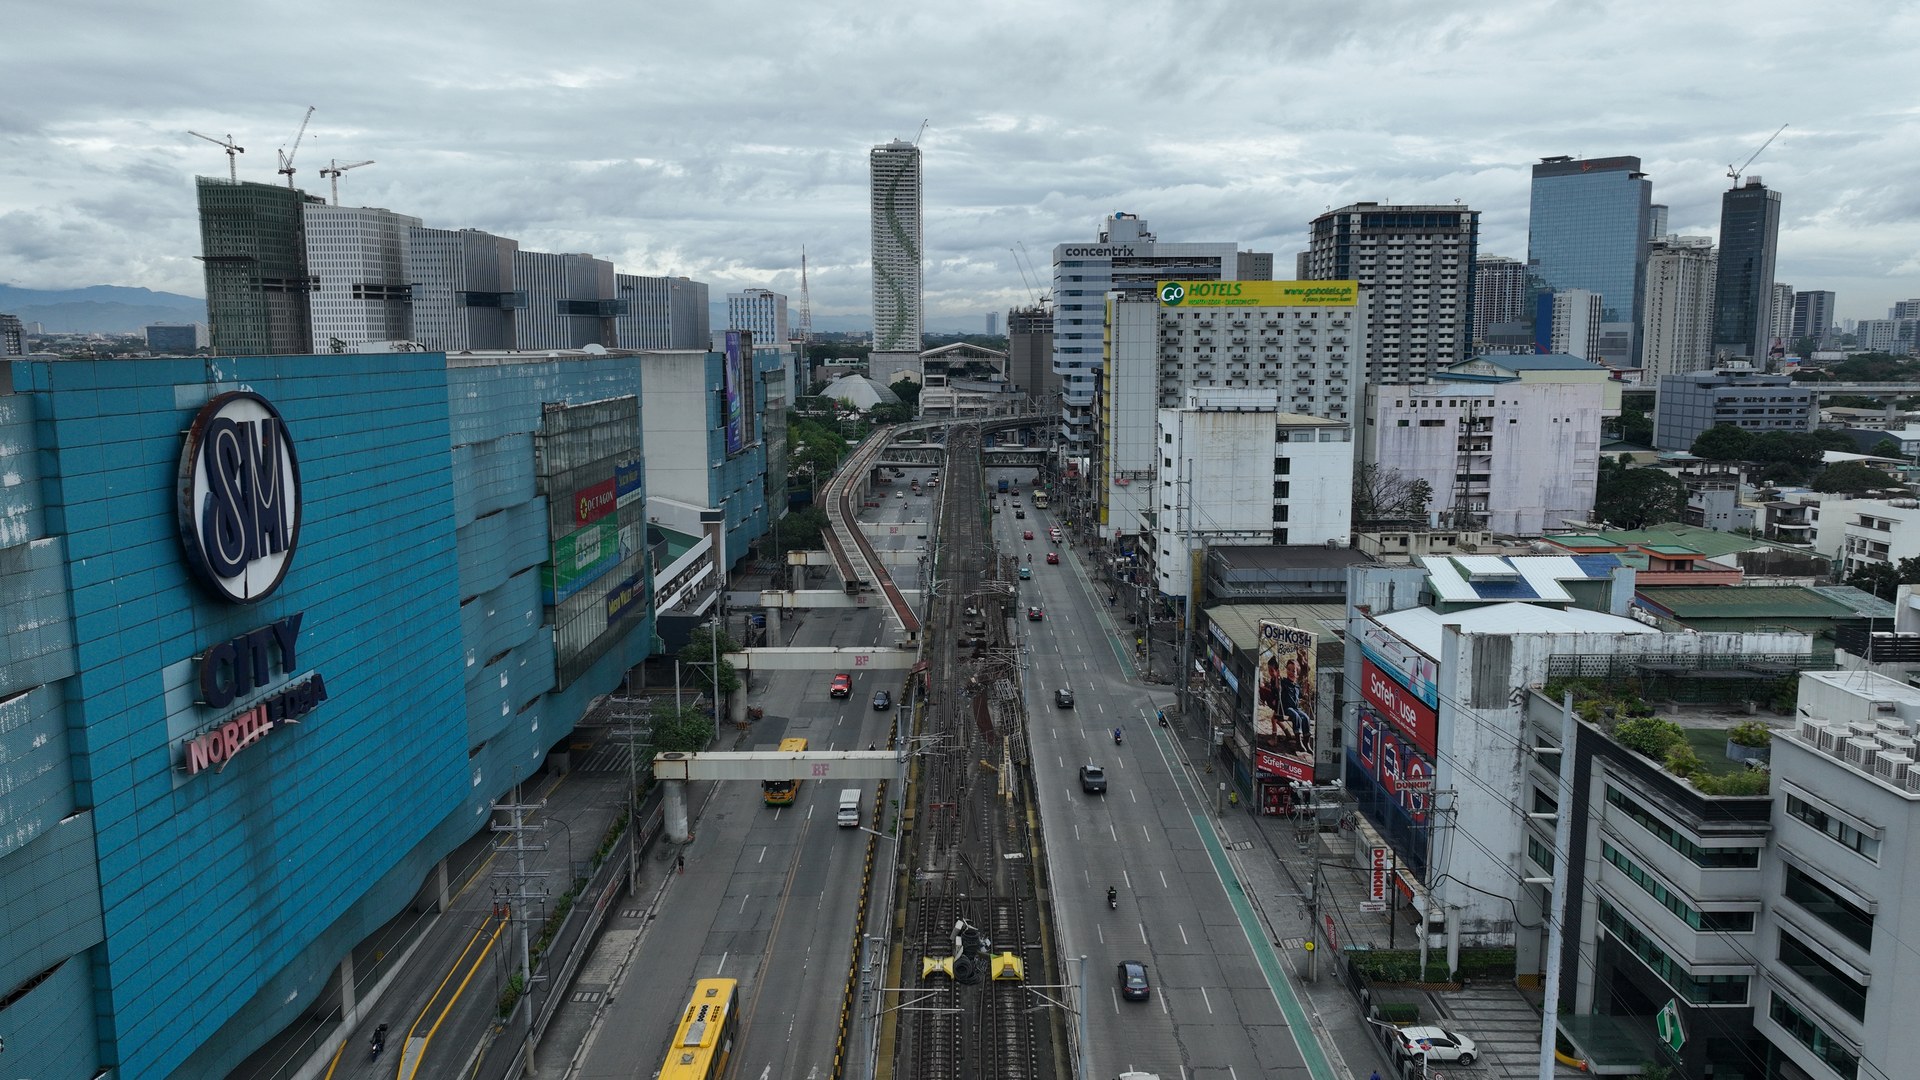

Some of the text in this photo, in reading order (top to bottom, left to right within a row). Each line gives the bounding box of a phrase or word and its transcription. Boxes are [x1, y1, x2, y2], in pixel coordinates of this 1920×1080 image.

[1065, 244, 1135, 257] concentrix
[1188, 283, 1242, 297] HOTELS
[1284, 286, 1352, 297] www.gohotels.ph
[203, 417, 289, 579] SM
[587, 490, 614, 512] OCTAGON
[1264, 624, 1312, 647] OSHKOSH
[201, 611, 304, 709] CITY
[185, 673, 328, 775] NORTH EDSA
[1396, 780, 1432, 790] DUNKIN'
[1373, 849, 1385, 900] DUNKIN'
